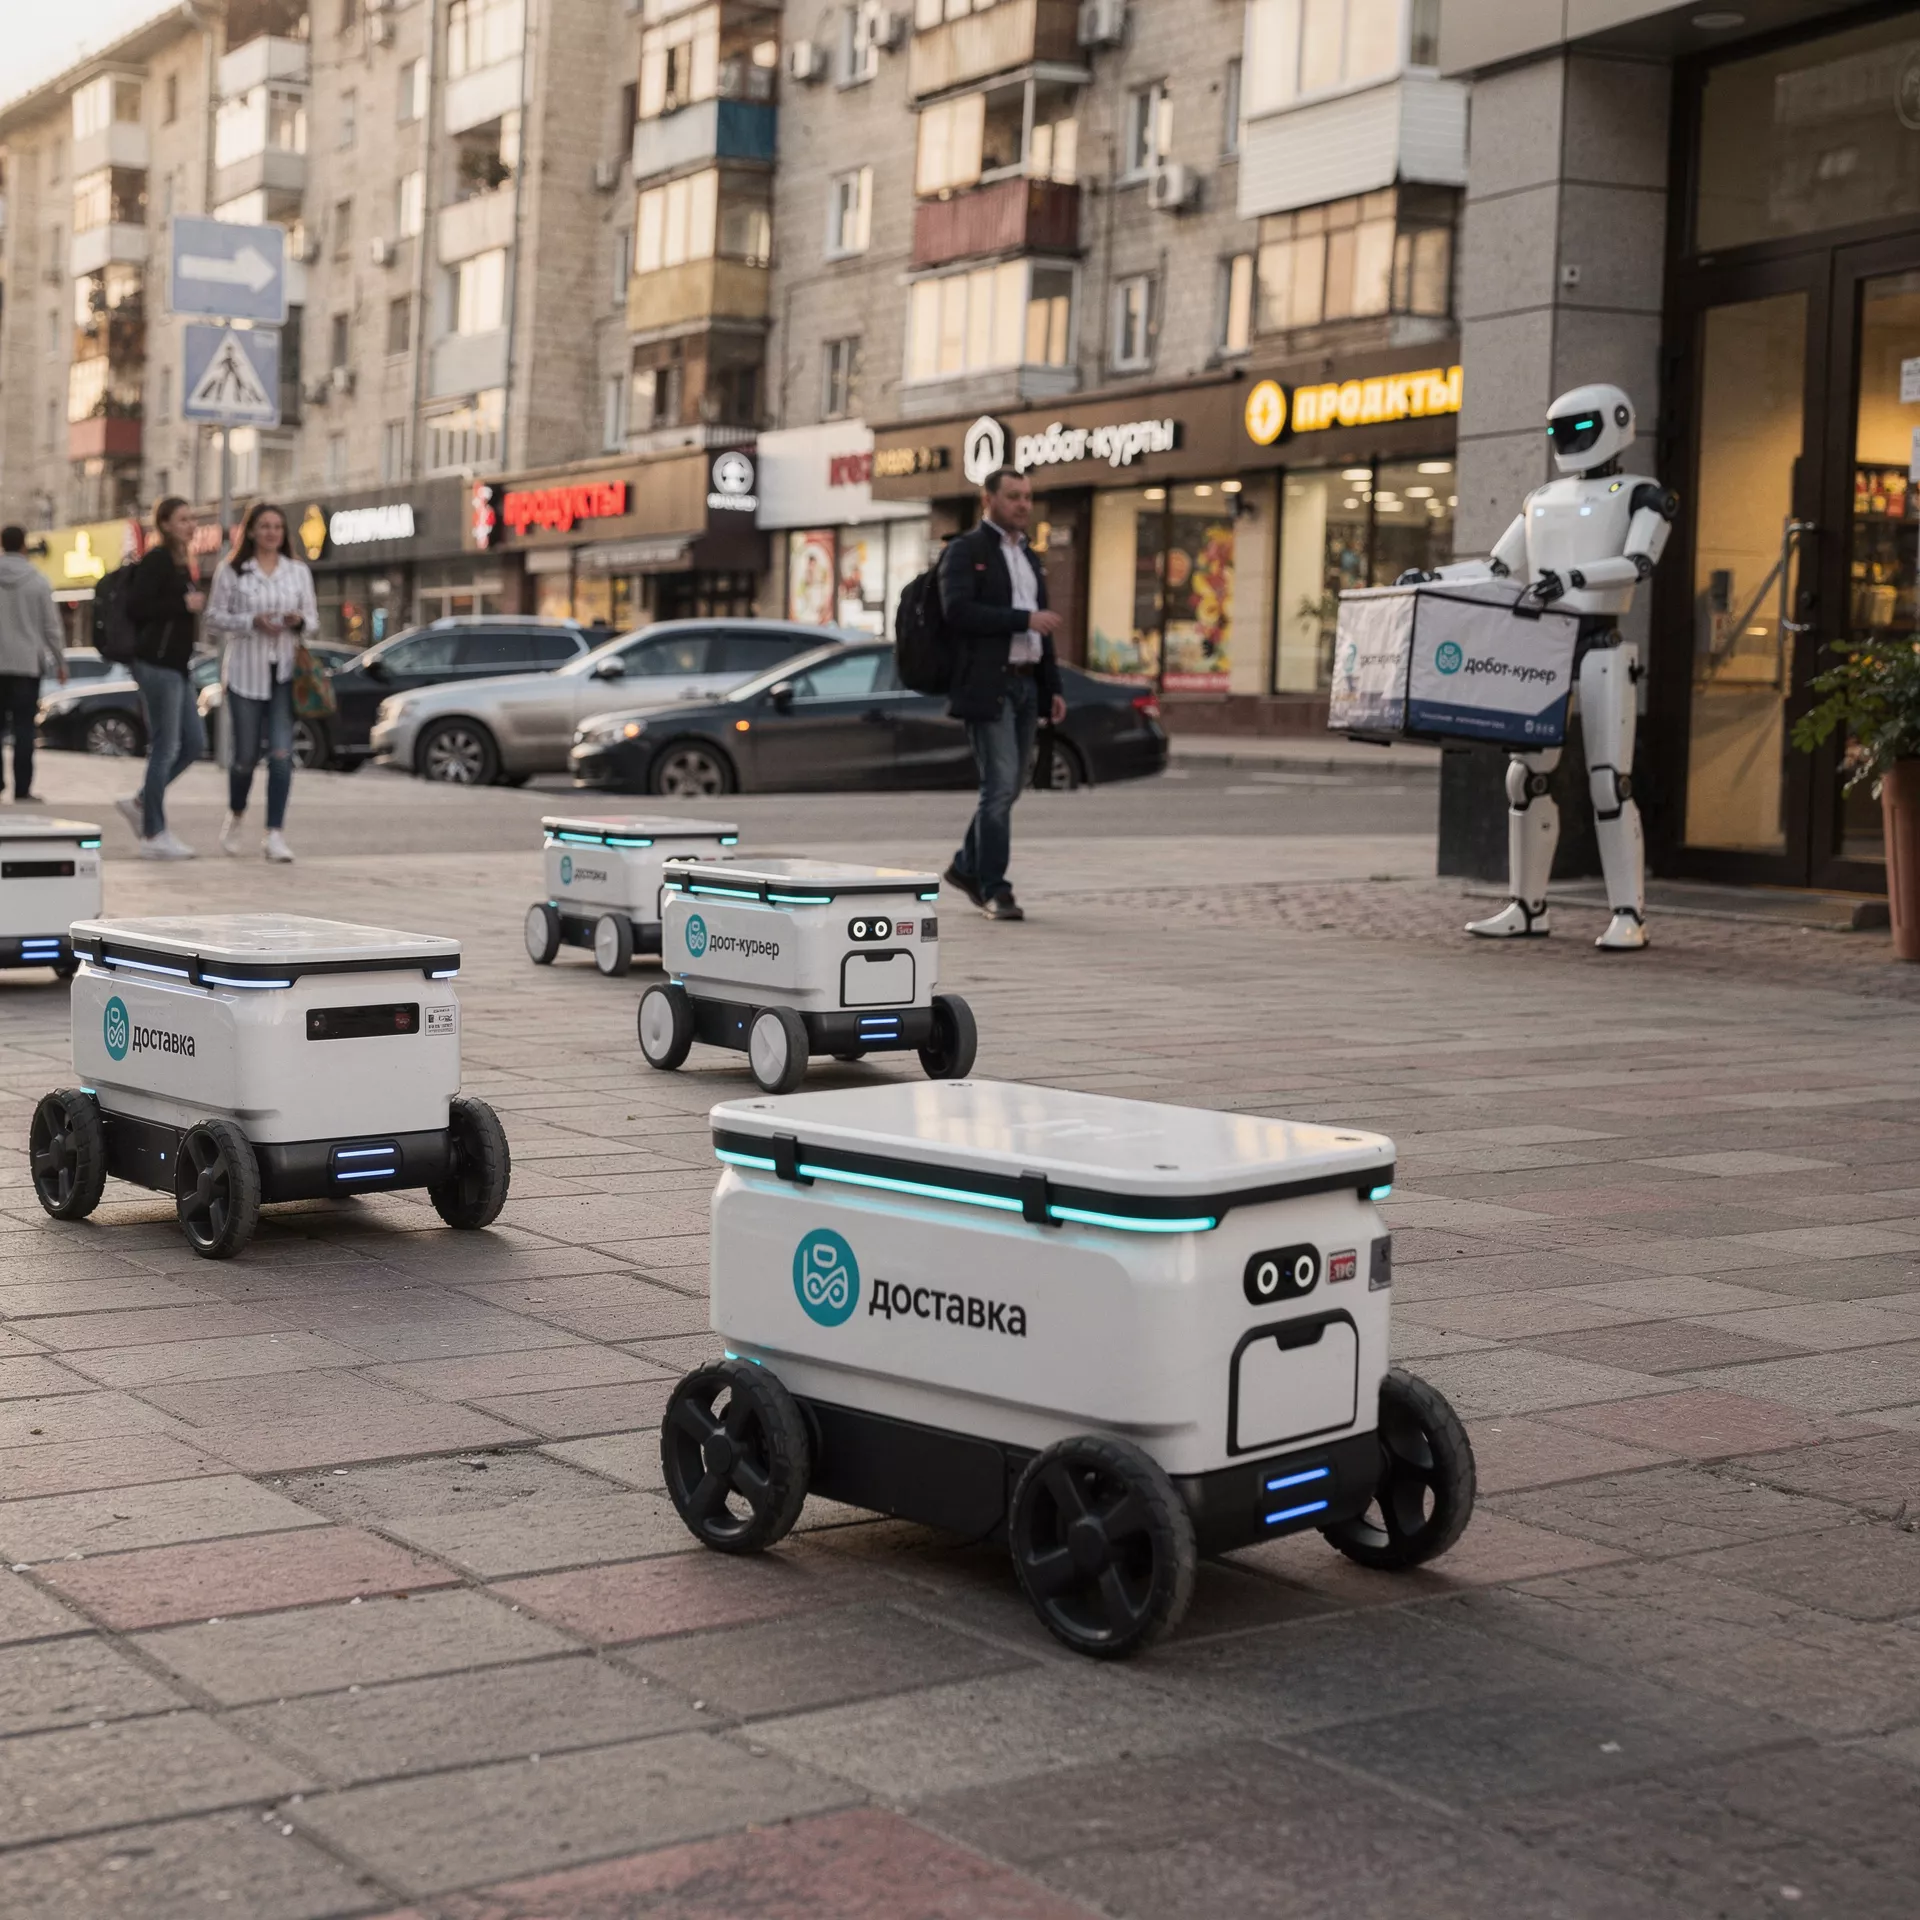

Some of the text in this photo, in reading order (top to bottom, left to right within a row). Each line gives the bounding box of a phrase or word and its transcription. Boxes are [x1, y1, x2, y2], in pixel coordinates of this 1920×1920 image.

[1464, 657, 1557, 686] добот-курер
[709, 934, 780, 961] доот-курьер
[132, 1025, 196, 1058] доставка
[868, 1278, 1027, 1338] доставка
